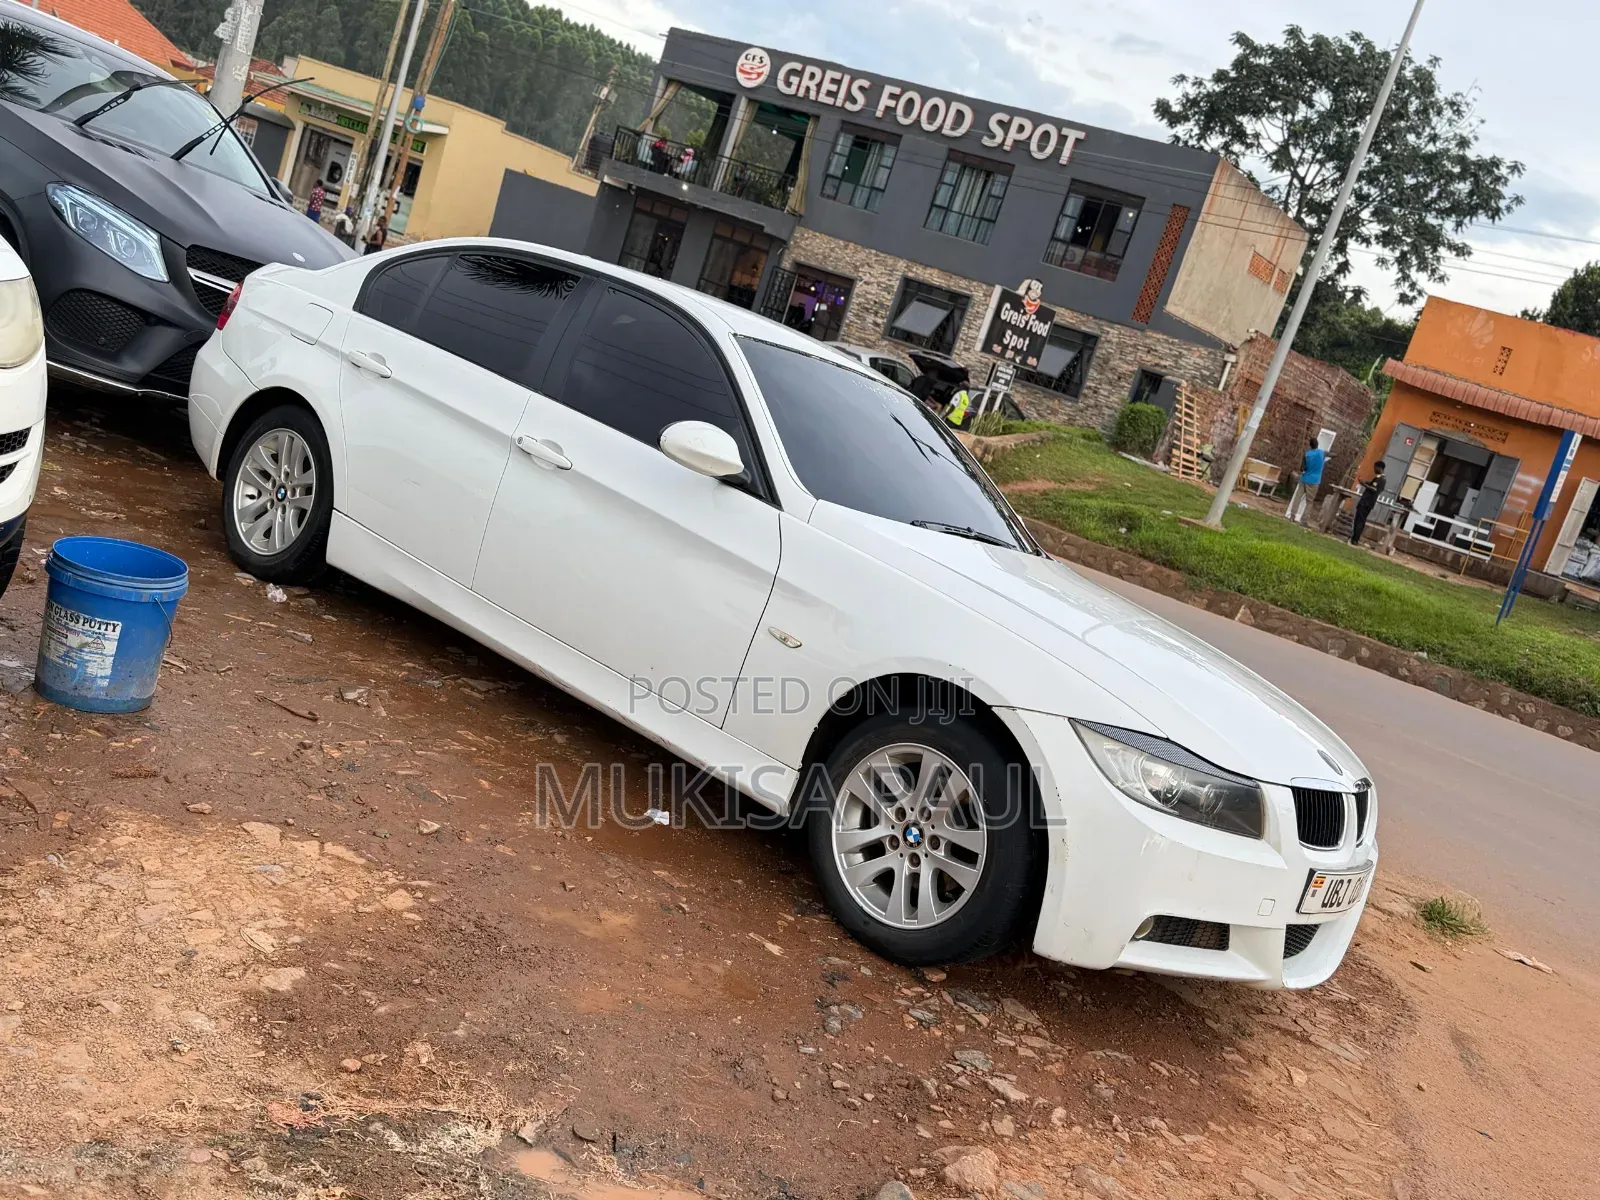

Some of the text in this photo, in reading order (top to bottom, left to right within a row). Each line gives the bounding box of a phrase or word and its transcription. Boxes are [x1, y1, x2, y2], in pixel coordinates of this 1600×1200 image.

[744, 52, 765, 64] GFS
[776, 61, 1087, 165] GREIS FOOD SPOT
[1000, 302, 1051, 338] Greis Food
[1002, 329, 1030, 352] Spot
[54, 605, 80, 625] GLASS
[82, 617, 120, 633] PUTTY
[1320, 878, 1352, 909] UBJ
